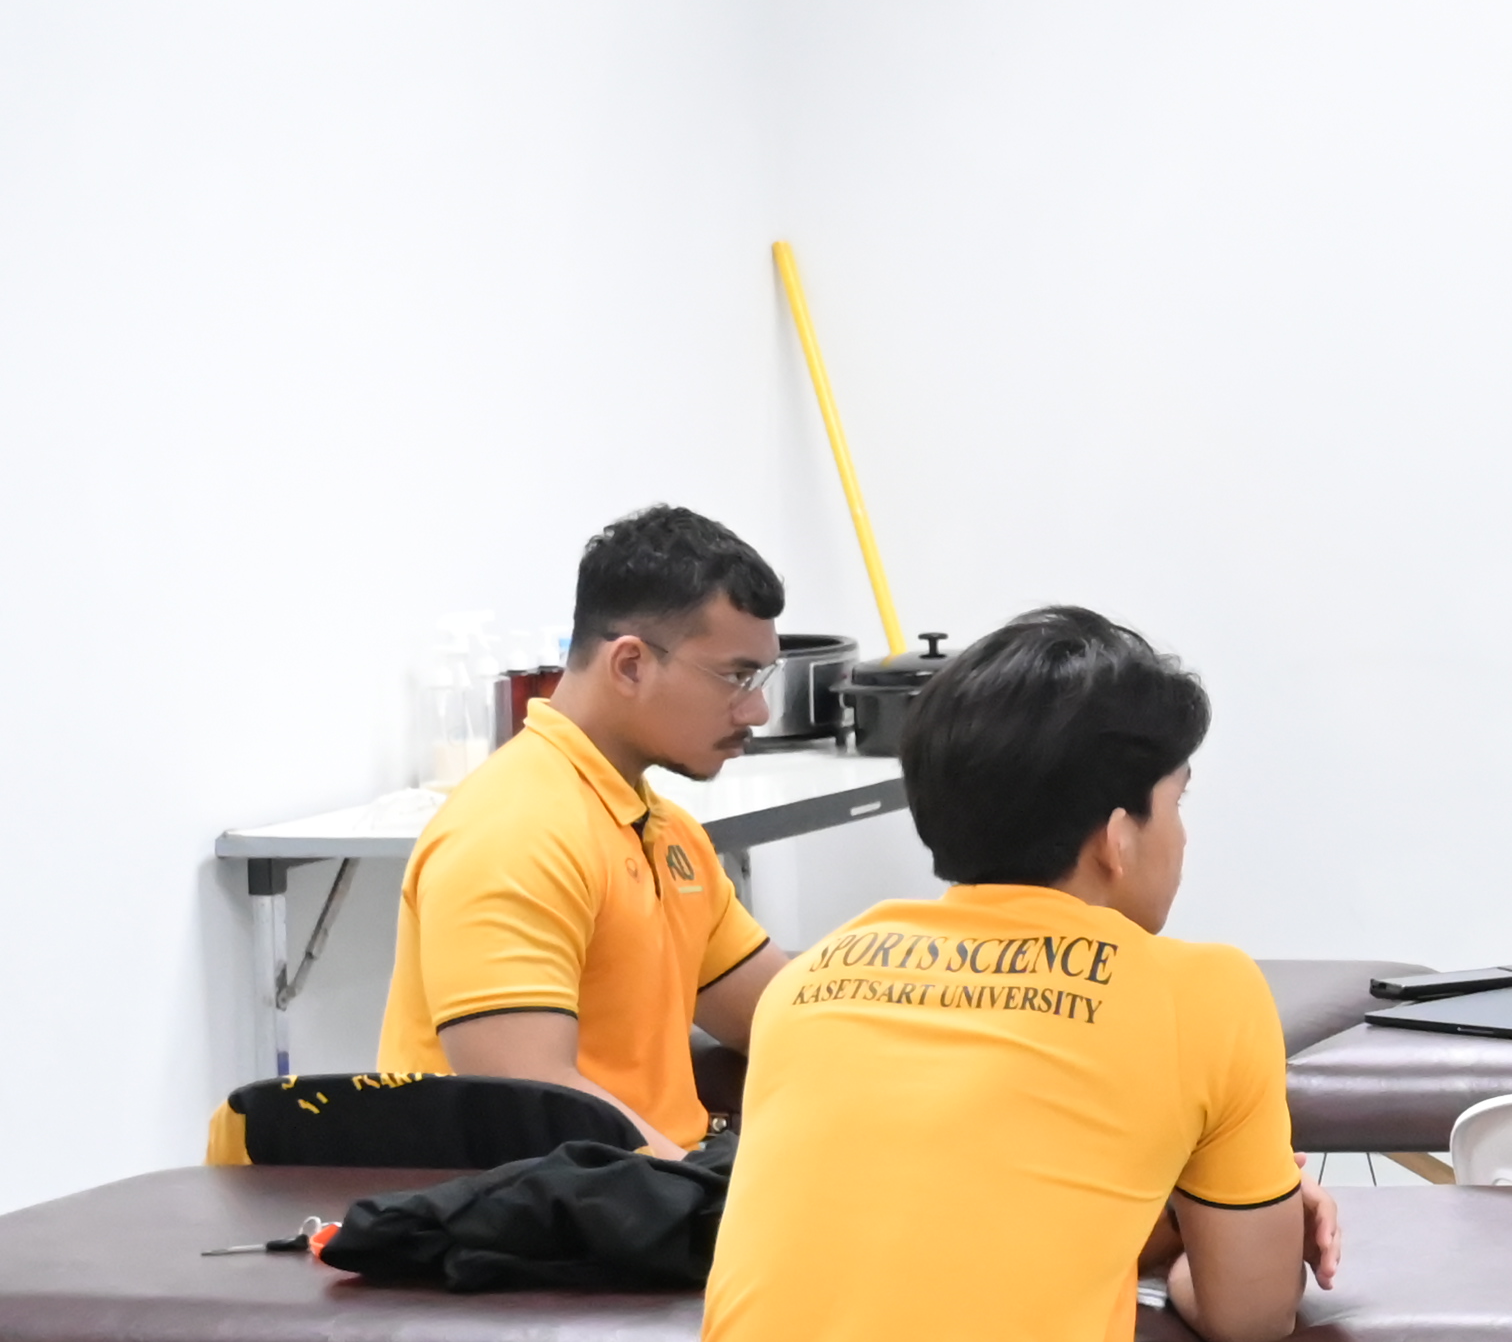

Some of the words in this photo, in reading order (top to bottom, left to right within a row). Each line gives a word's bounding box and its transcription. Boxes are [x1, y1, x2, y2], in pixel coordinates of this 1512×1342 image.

[809, 932, 949, 972] SPORTS
[945, 935, 1118, 985] SCIENCE
[792, 978, 936, 1006] KASETSART
[939, 984, 1103, 1025] UNIVERSITY
